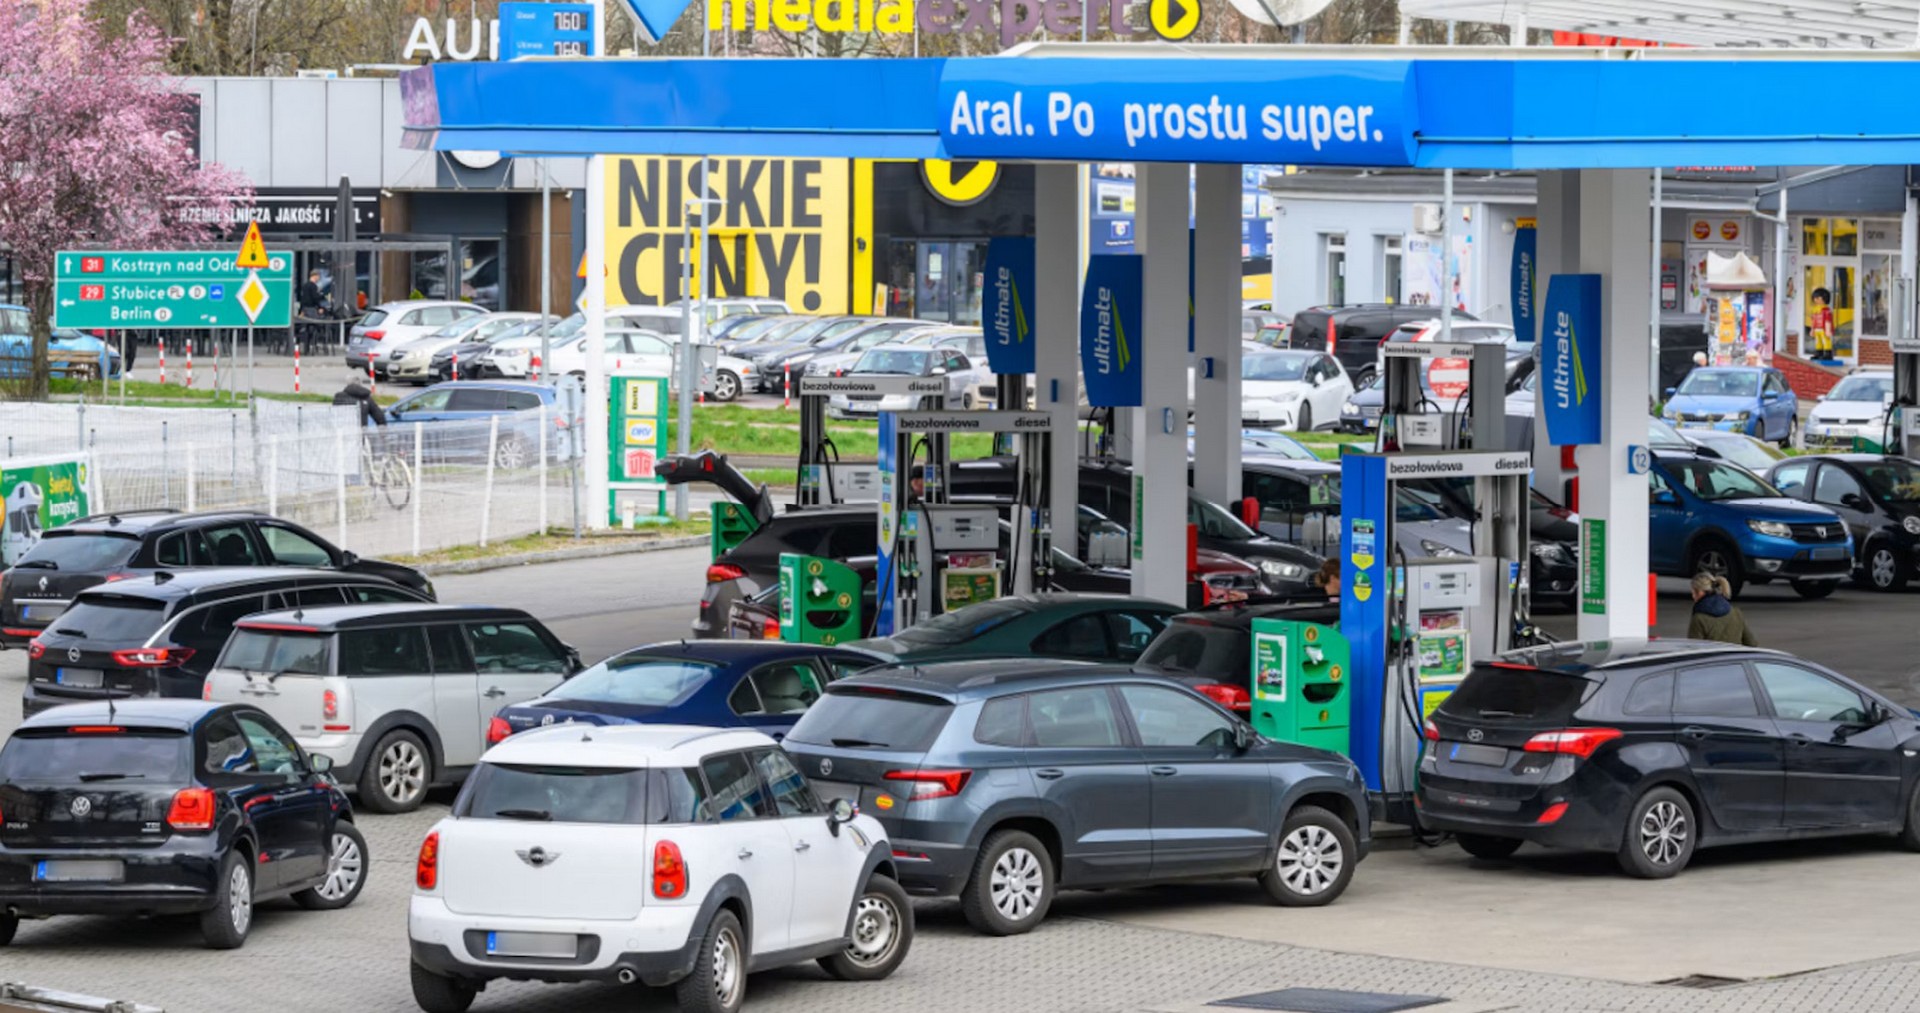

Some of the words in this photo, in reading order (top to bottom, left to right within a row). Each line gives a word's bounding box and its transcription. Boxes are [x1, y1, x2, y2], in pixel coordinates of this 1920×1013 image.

[403, 17, 499, 60] AU
[950, 90, 1034, 136] Aral.
[1048, 91, 1094, 138] Po
[1124, 95, 1248, 148] prostu
[1262, 104, 1383, 151] super.
[618, 158, 822, 228] NISKIE
[275, 204, 321, 223] JAKOŚĆ
[325, 208, 330, 223] I
[86, 259, 99, 271] 31
[111, 256, 172, 275] Kostrzyn
[177, 257, 204, 272] nad
[272, 259, 281, 270] D
[618, 232, 822, 311] CENY!
[85, 287, 99, 299] 29
[111, 285, 165, 300] Słubice
[169, 288, 181, 297] PL
[193, 288, 202, 298] D
[1519, 251, 1529, 318] ultimate
[111, 306, 152, 320] Berlin
[159, 310, 168, 319] D
[994, 266, 1011, 345] ultimate
[1094, 287, 1111, 375] ultimate
[1451, 347, 1474, 356] diesel
[1552, 310, 1569, 409] ultimate
[802, 381, 876, 392] bezołowiowa
[908, 381, 942, 392] diesel
[900, 417, 980, 429] bezołowiowa
[1014, 416, 1051, 428] diesel
[1390, 461, 1463, 474] bezołowiowa
[1495, 457, 1528, 470] diesel
[1635, 453, 1647, 467] 12
